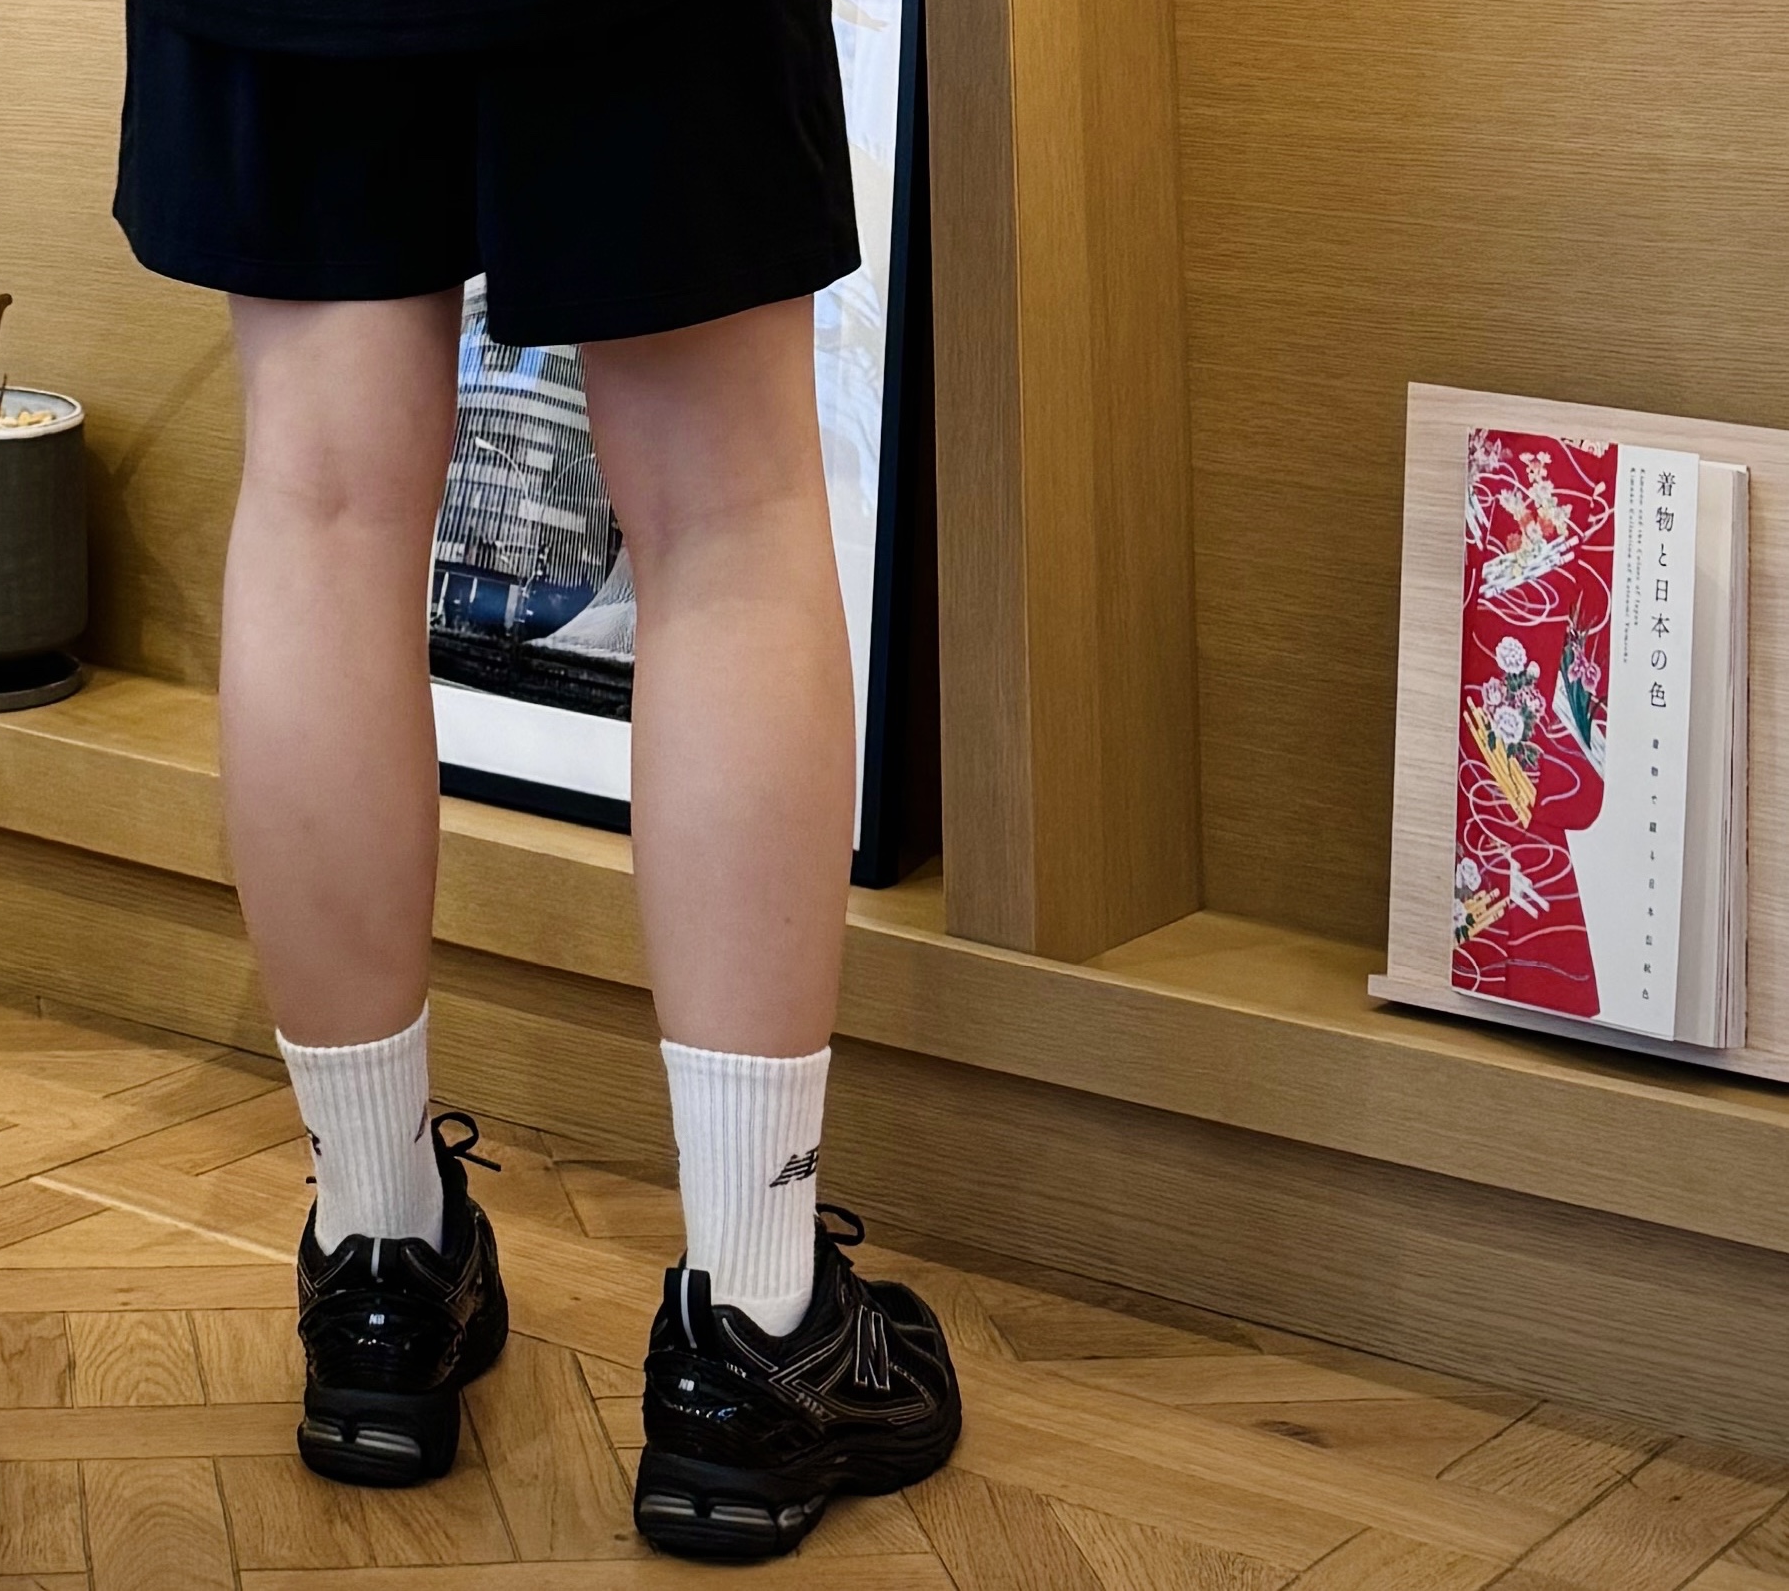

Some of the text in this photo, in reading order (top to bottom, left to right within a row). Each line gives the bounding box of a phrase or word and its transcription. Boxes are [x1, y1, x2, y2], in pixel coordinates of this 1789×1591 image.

[1648, 470, 1677, 710] 着物と日本の色
